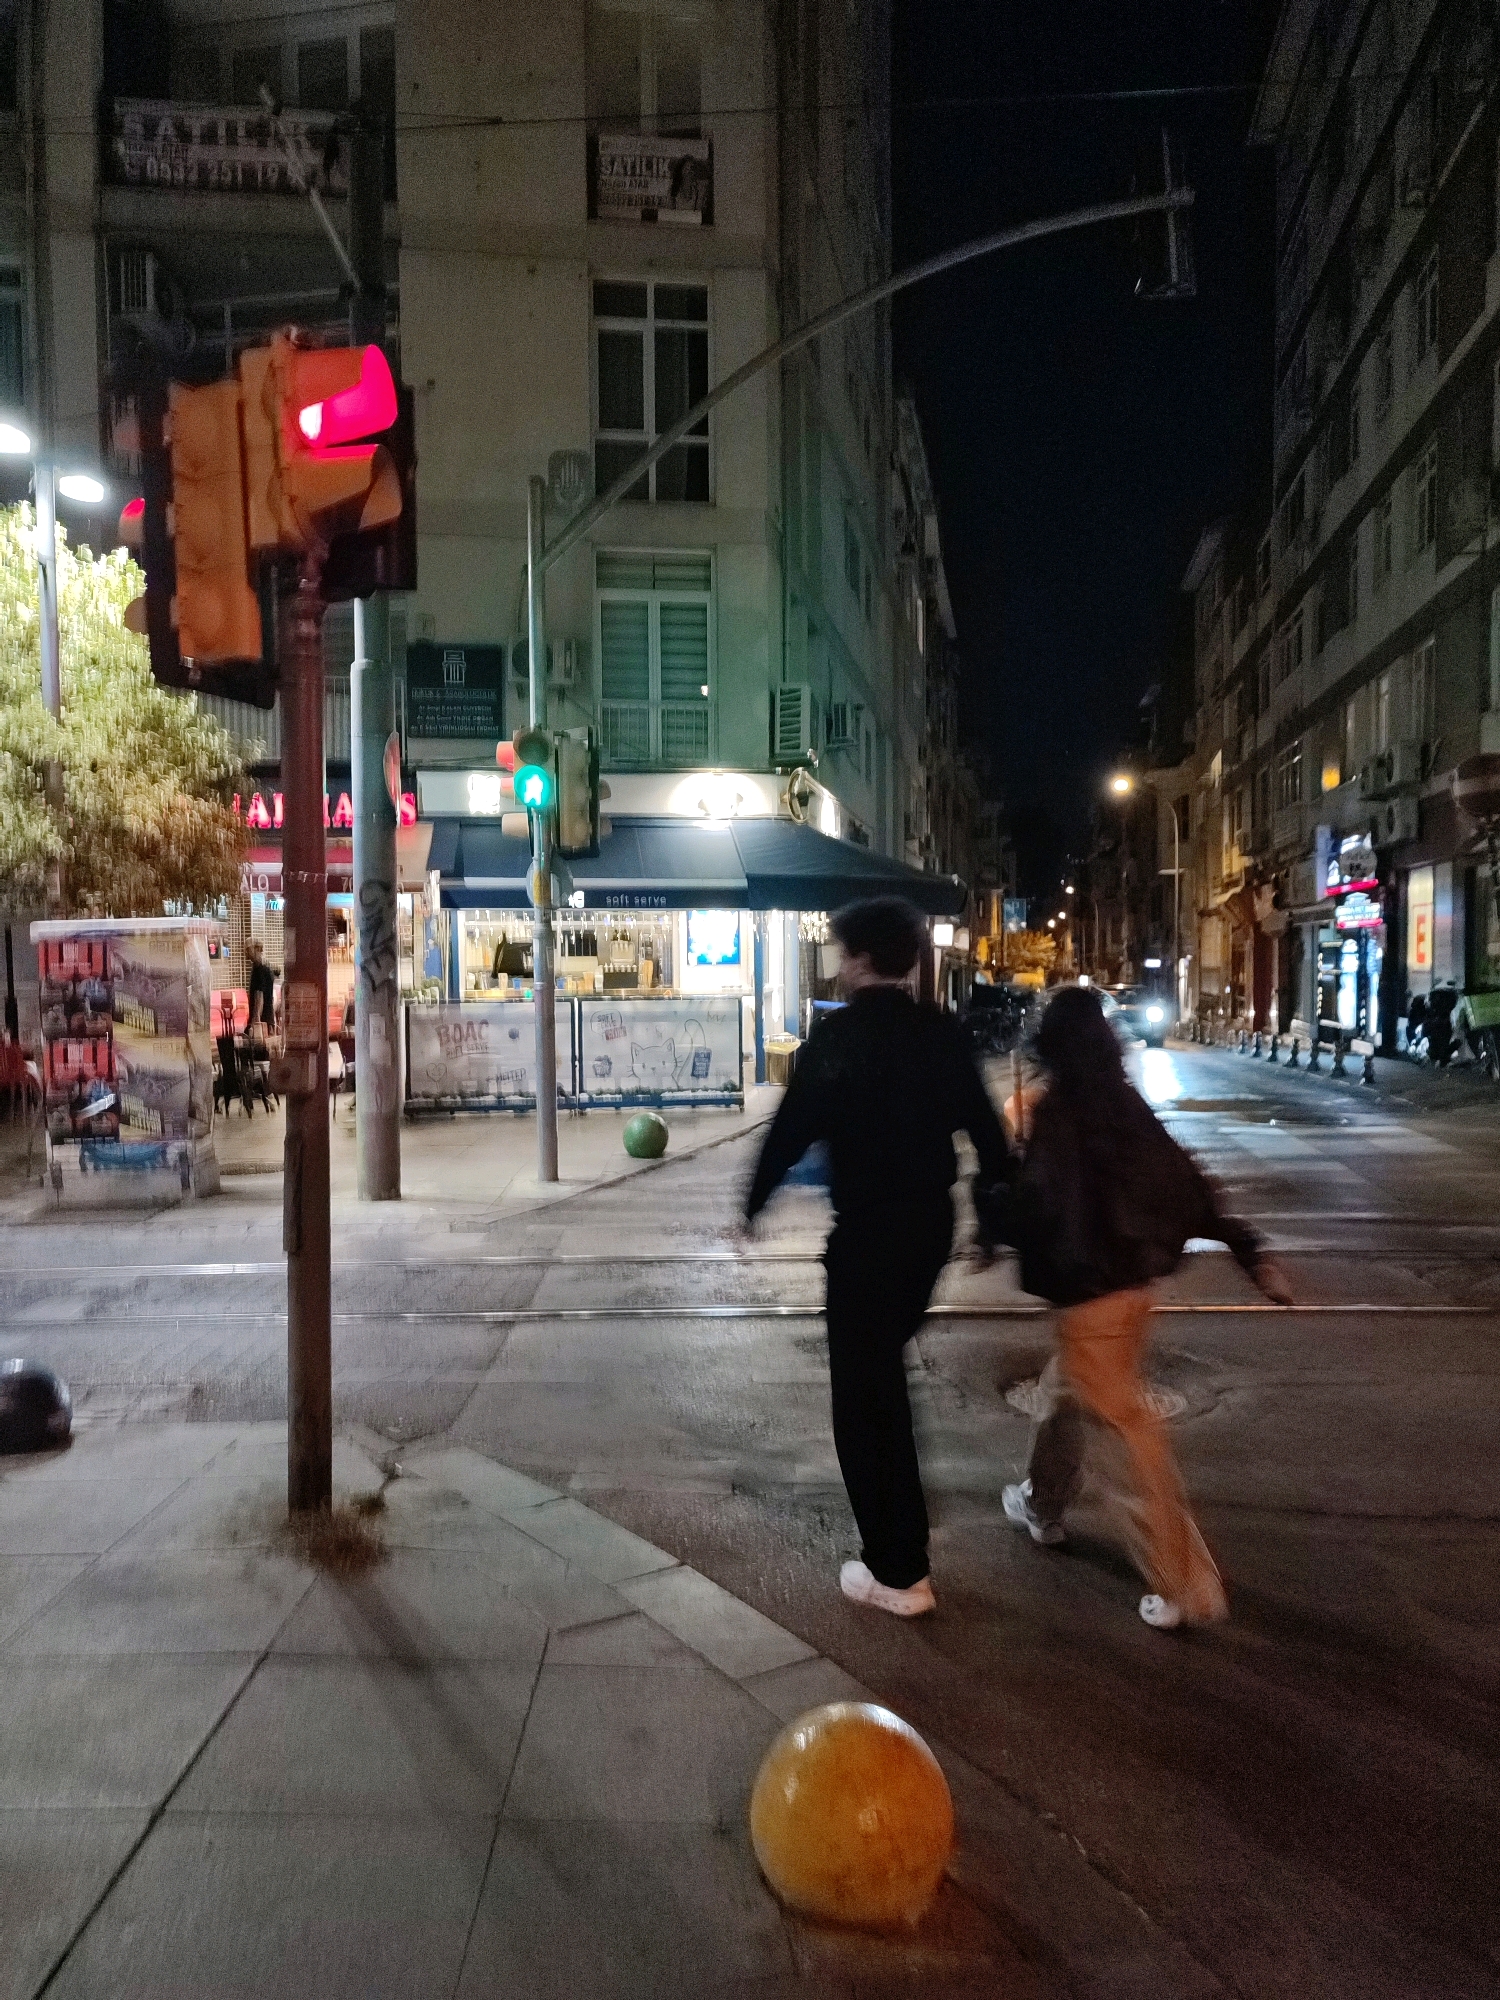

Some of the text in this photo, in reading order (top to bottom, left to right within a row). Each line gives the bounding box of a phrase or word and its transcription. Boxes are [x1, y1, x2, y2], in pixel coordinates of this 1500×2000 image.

[600, 155, 672, 177] SATILIK
[605, 893, 667, 905] soft serve
